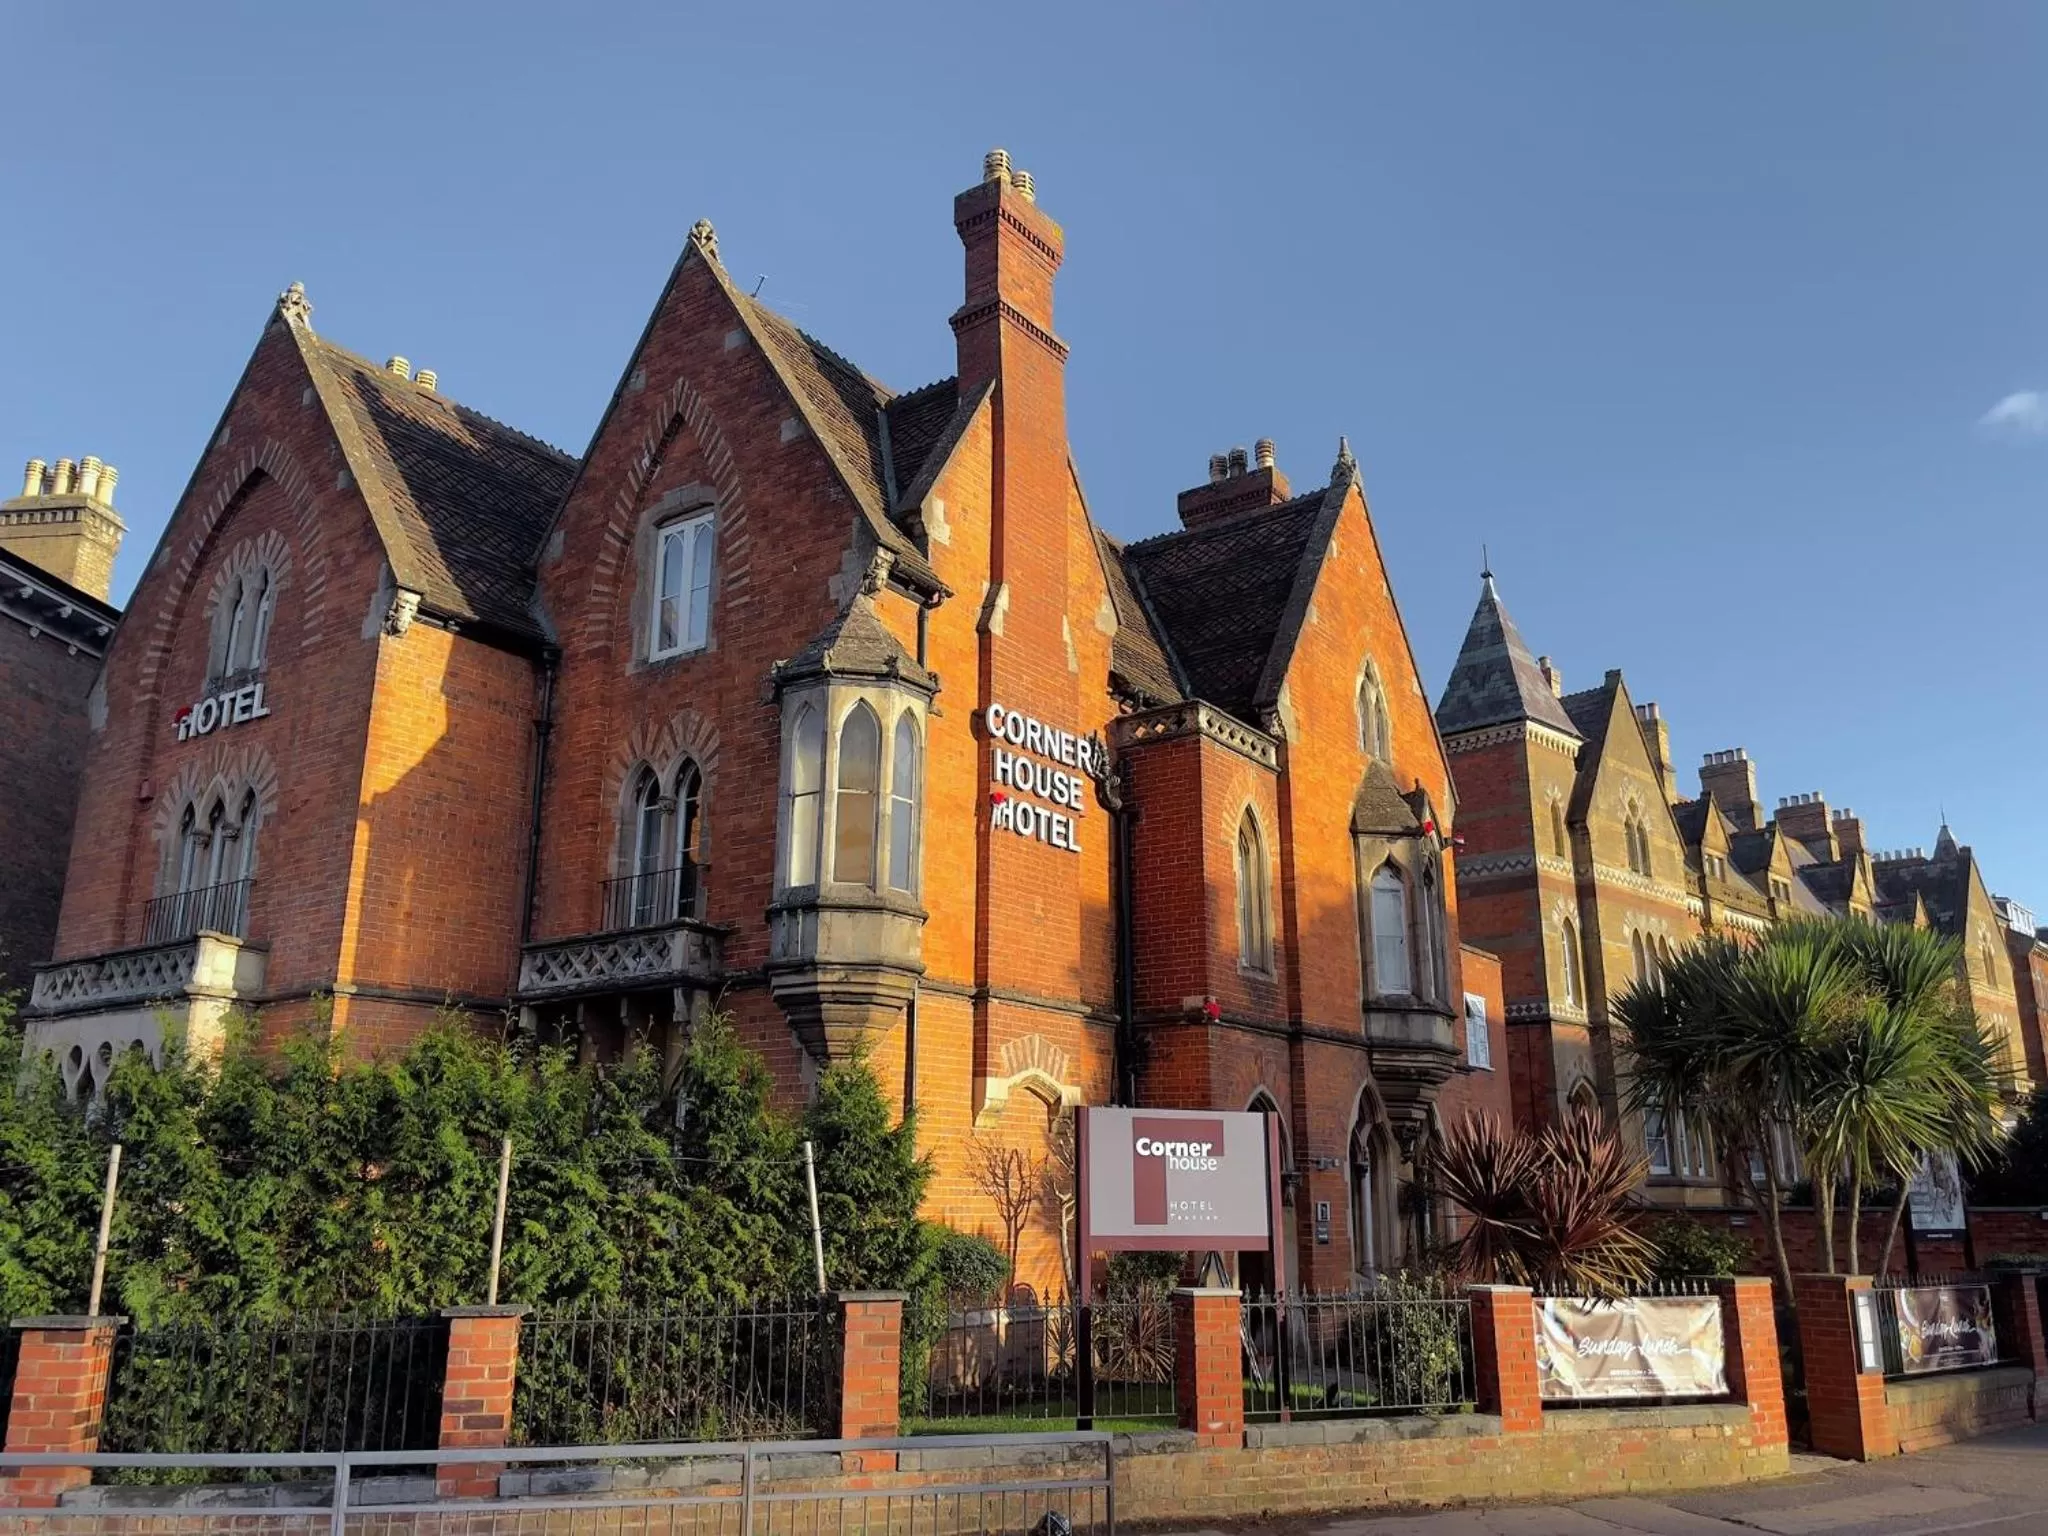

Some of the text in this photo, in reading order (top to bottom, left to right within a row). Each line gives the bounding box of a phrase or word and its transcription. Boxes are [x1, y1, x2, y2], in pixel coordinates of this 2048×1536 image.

[178, 683, 271, 741] HOTEL
[986, 703, 1094, 776] CORNER
[995, 748, 1084, 811] HOUSE
[994, 797, 1082, 853] HOTEL
[1135, 1137, 1213, 1157] Corner
[1169, 1154, 1218, 1171] house
[1170, 1200, 1213, 1211] HOTEL
[1577, 1336, 1636, 1361] Sunday
